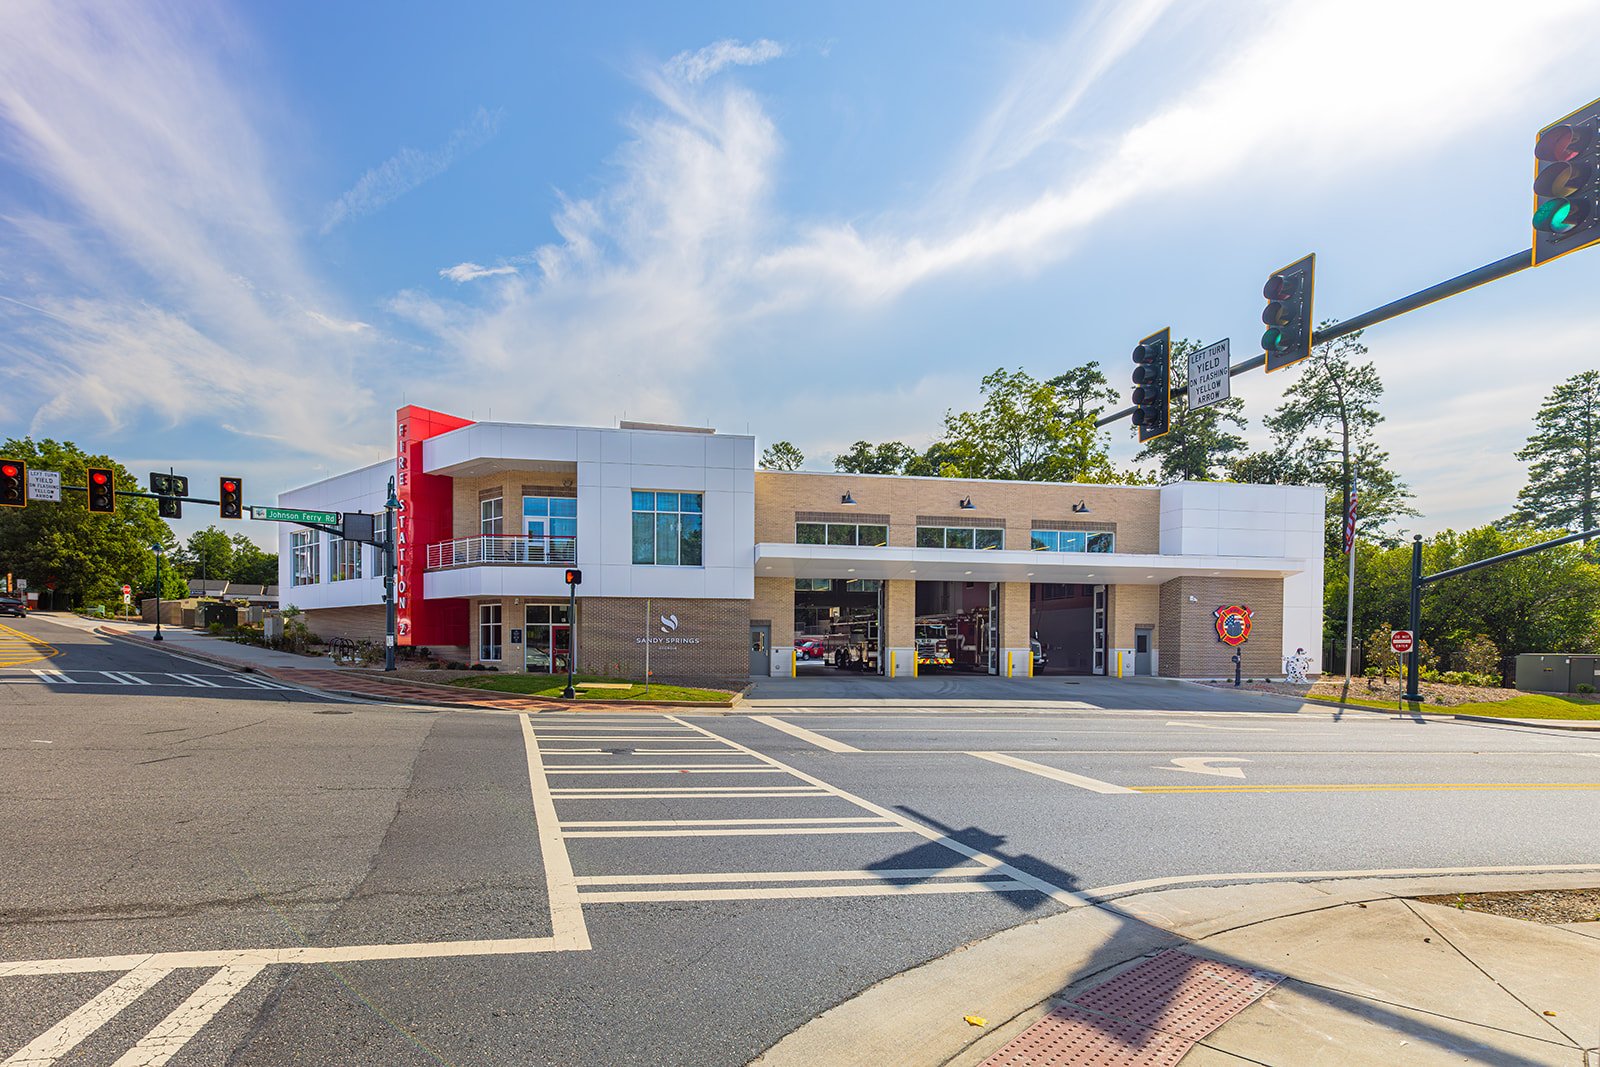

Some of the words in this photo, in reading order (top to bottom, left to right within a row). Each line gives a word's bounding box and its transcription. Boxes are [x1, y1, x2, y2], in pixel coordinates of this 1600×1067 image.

[1191, 352, 1206, 364] LEFT
[1208, 344, 1226, 357] TURN
[1197, 357, 1220, 374] YIELD
[1190, 378, 1198, 388] ON
[1200, 367, 1228, 383] FLASHING
[1196, 380, 1221, 395] YELLOW
[1198, 391, 1220, 404] ARROW
[399, 424, 407, 486] FIRE
[268, 511, 299, 520] Johnson
[302, 514, 322, 522] Ferry
[398, 499, 406, 609] STATION
[399, 623, 406, 635] 2
